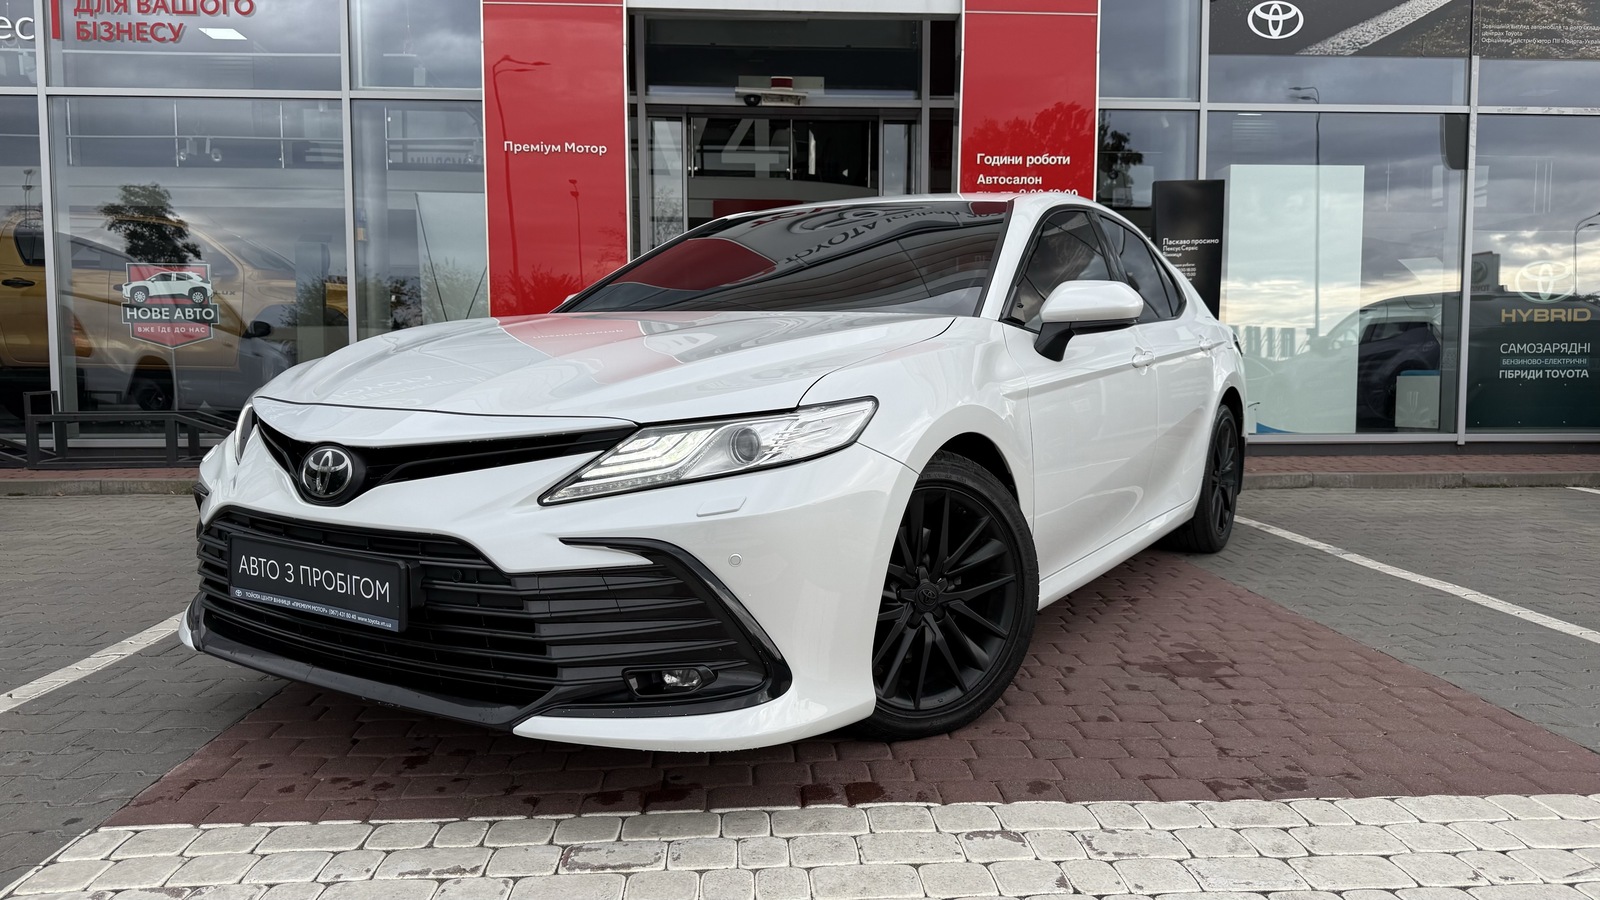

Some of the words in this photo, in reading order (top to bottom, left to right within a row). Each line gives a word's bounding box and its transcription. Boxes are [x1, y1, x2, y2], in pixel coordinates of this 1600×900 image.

[73, 0, 125, 17] ДЛЯ
[137, 0, 255, 16] ВАШОГО
[75, 21, 184, 42] БІЗНЕСУ
[503, 140, 561, 155] Преміум
[564, 142, 607, 156] Мотор
[976, 153, 1023, 167] Години
[1026, 153, 1071, 167] роботи
[976, 173, 1043, 185] Автосалон
[126, 307, 170, 320] НОВЕ
[174, 308, 215, 320] АВТО
[1501, 308, 1592, 322] HYBRID
[1500, 343, 1590, 354] САМОЗАРЯДНІ
[1499, 369, 1543, 380] ГІБРИДИ
[1545, 369, 1589, 378] TOYOTA
[238, 555, 280, 580] АВТО
[284, 562, 295, 583] З
[300, 565, 390, 603] ПРОБІГОМ
[260, 594, 273, 602] ЦЕНТР
[328, 608, 339, 617] (067)
